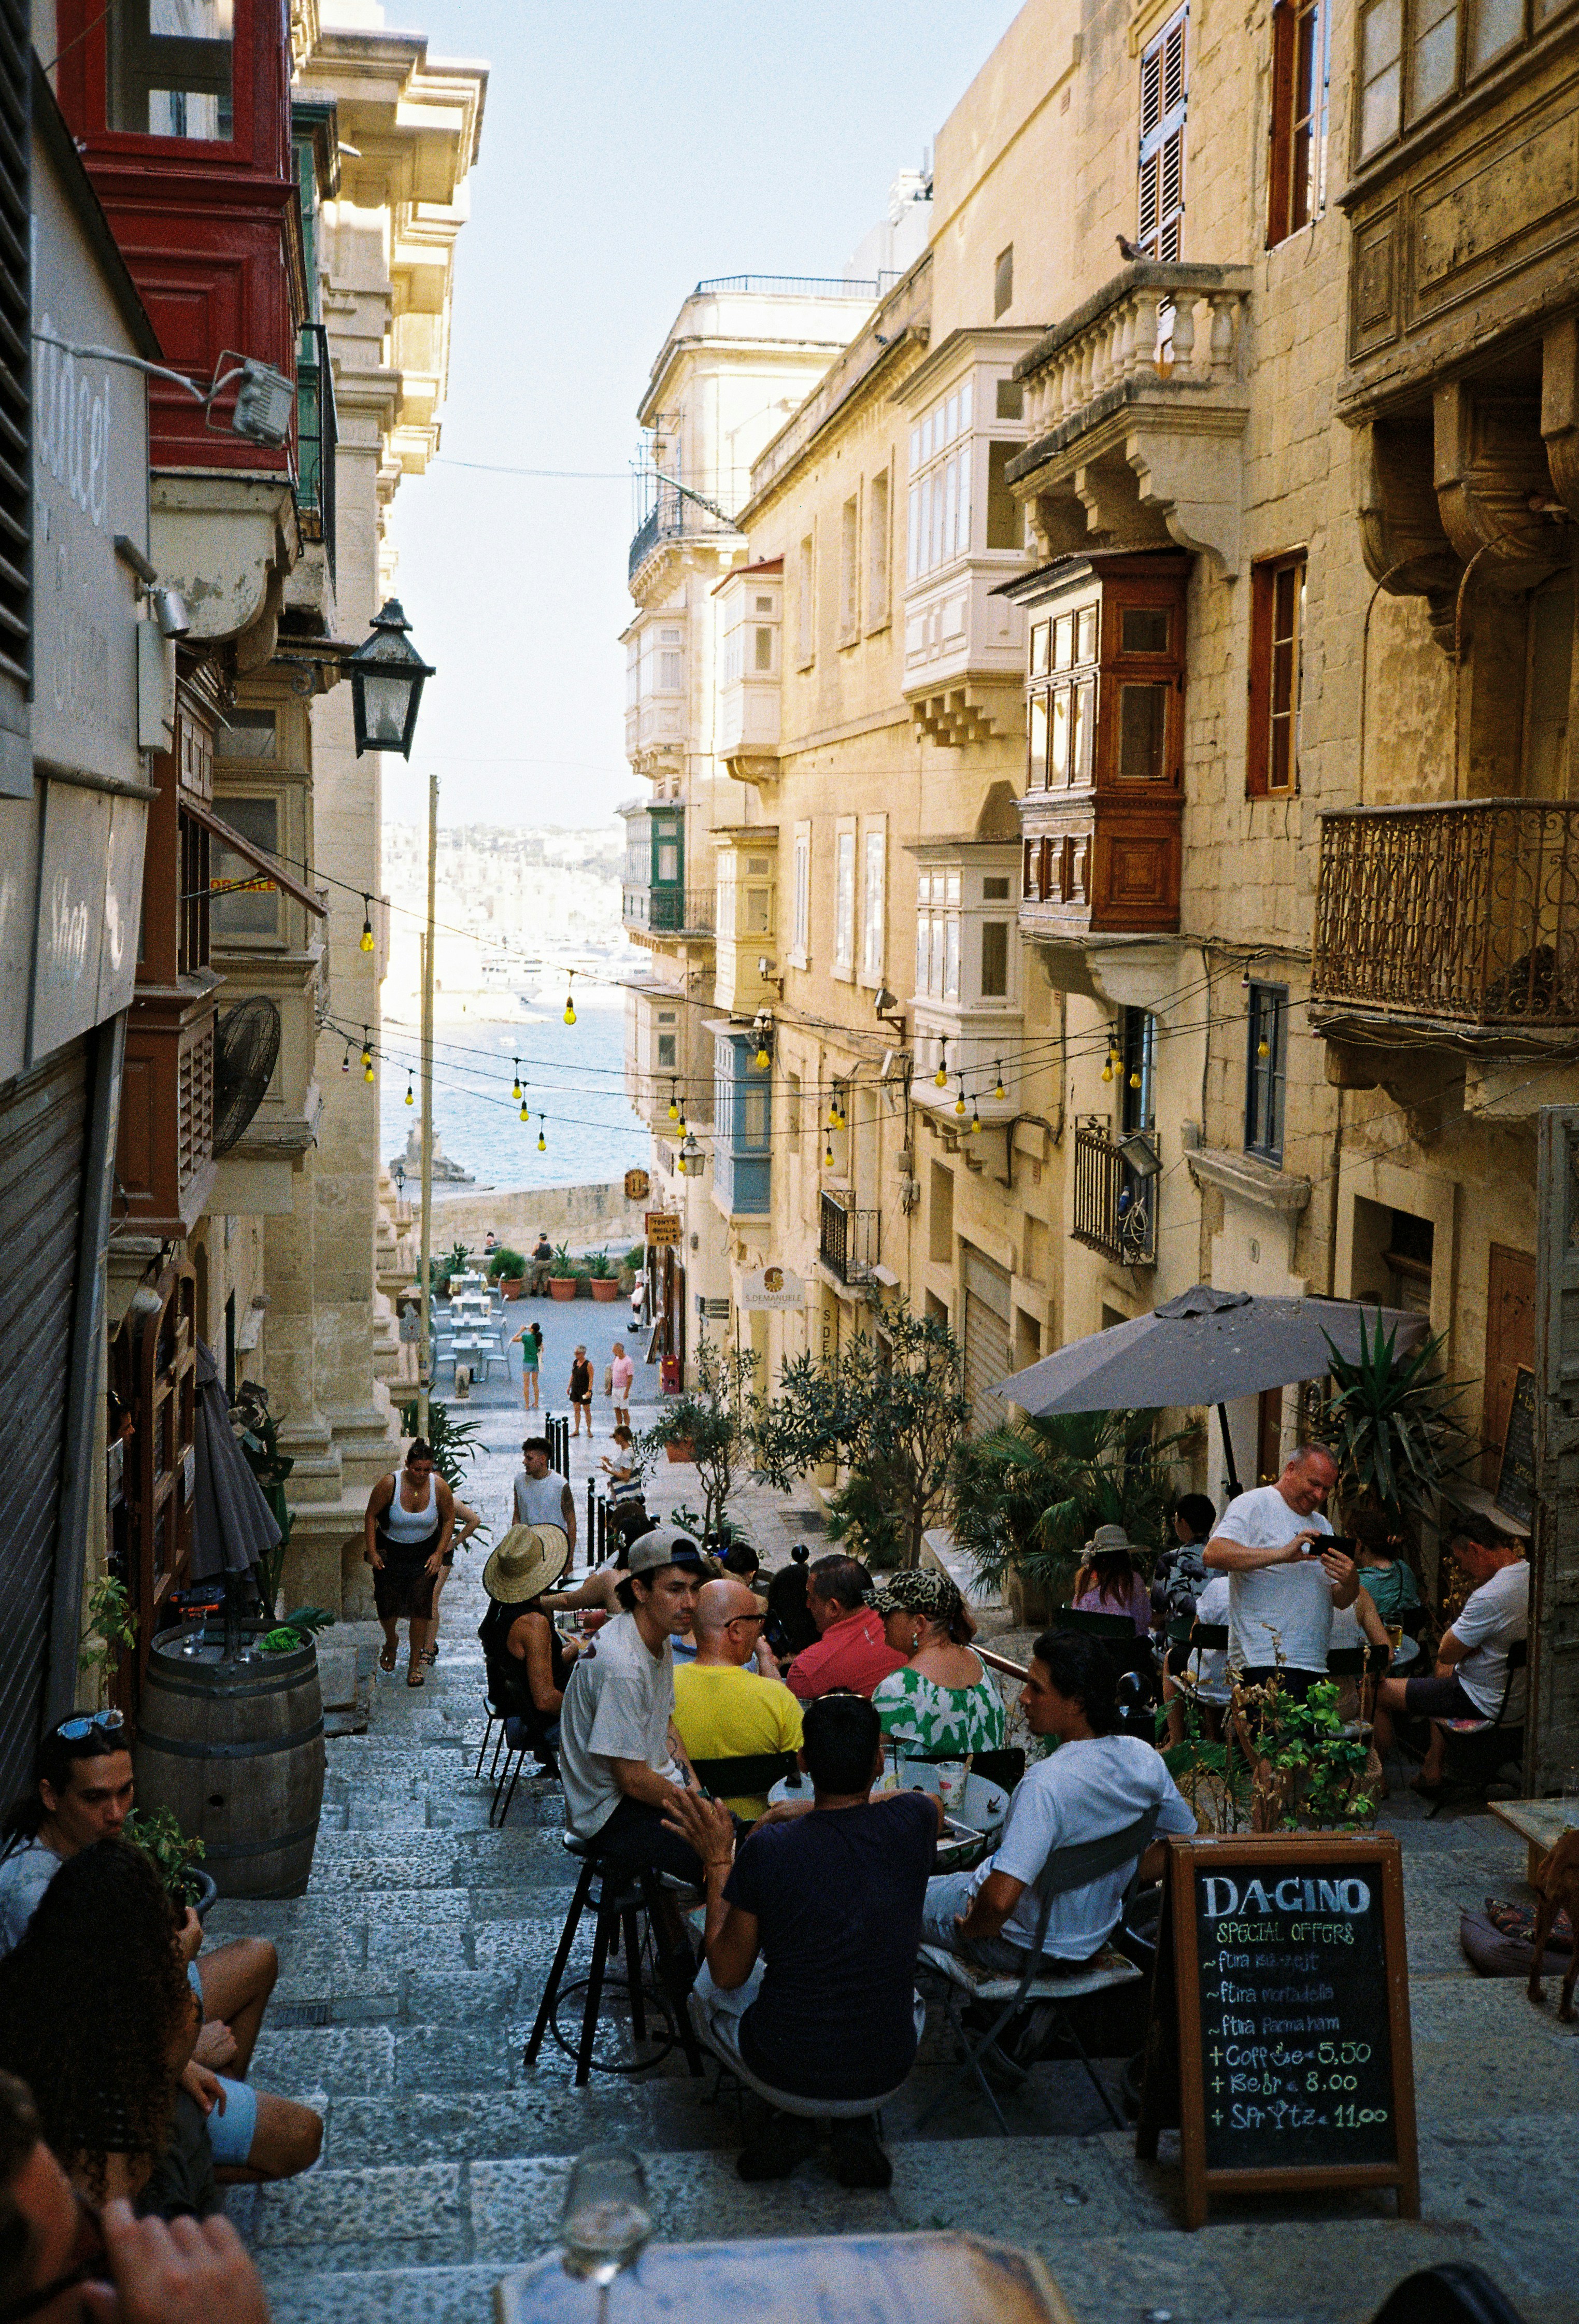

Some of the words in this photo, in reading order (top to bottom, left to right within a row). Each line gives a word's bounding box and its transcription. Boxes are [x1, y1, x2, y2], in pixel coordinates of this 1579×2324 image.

[1217, 1921, 1285, 1944] SPECIAL
[1291, 1922, 1354, 1945] OFFERS
[1220, 1981, 1256, 2003] ftira
